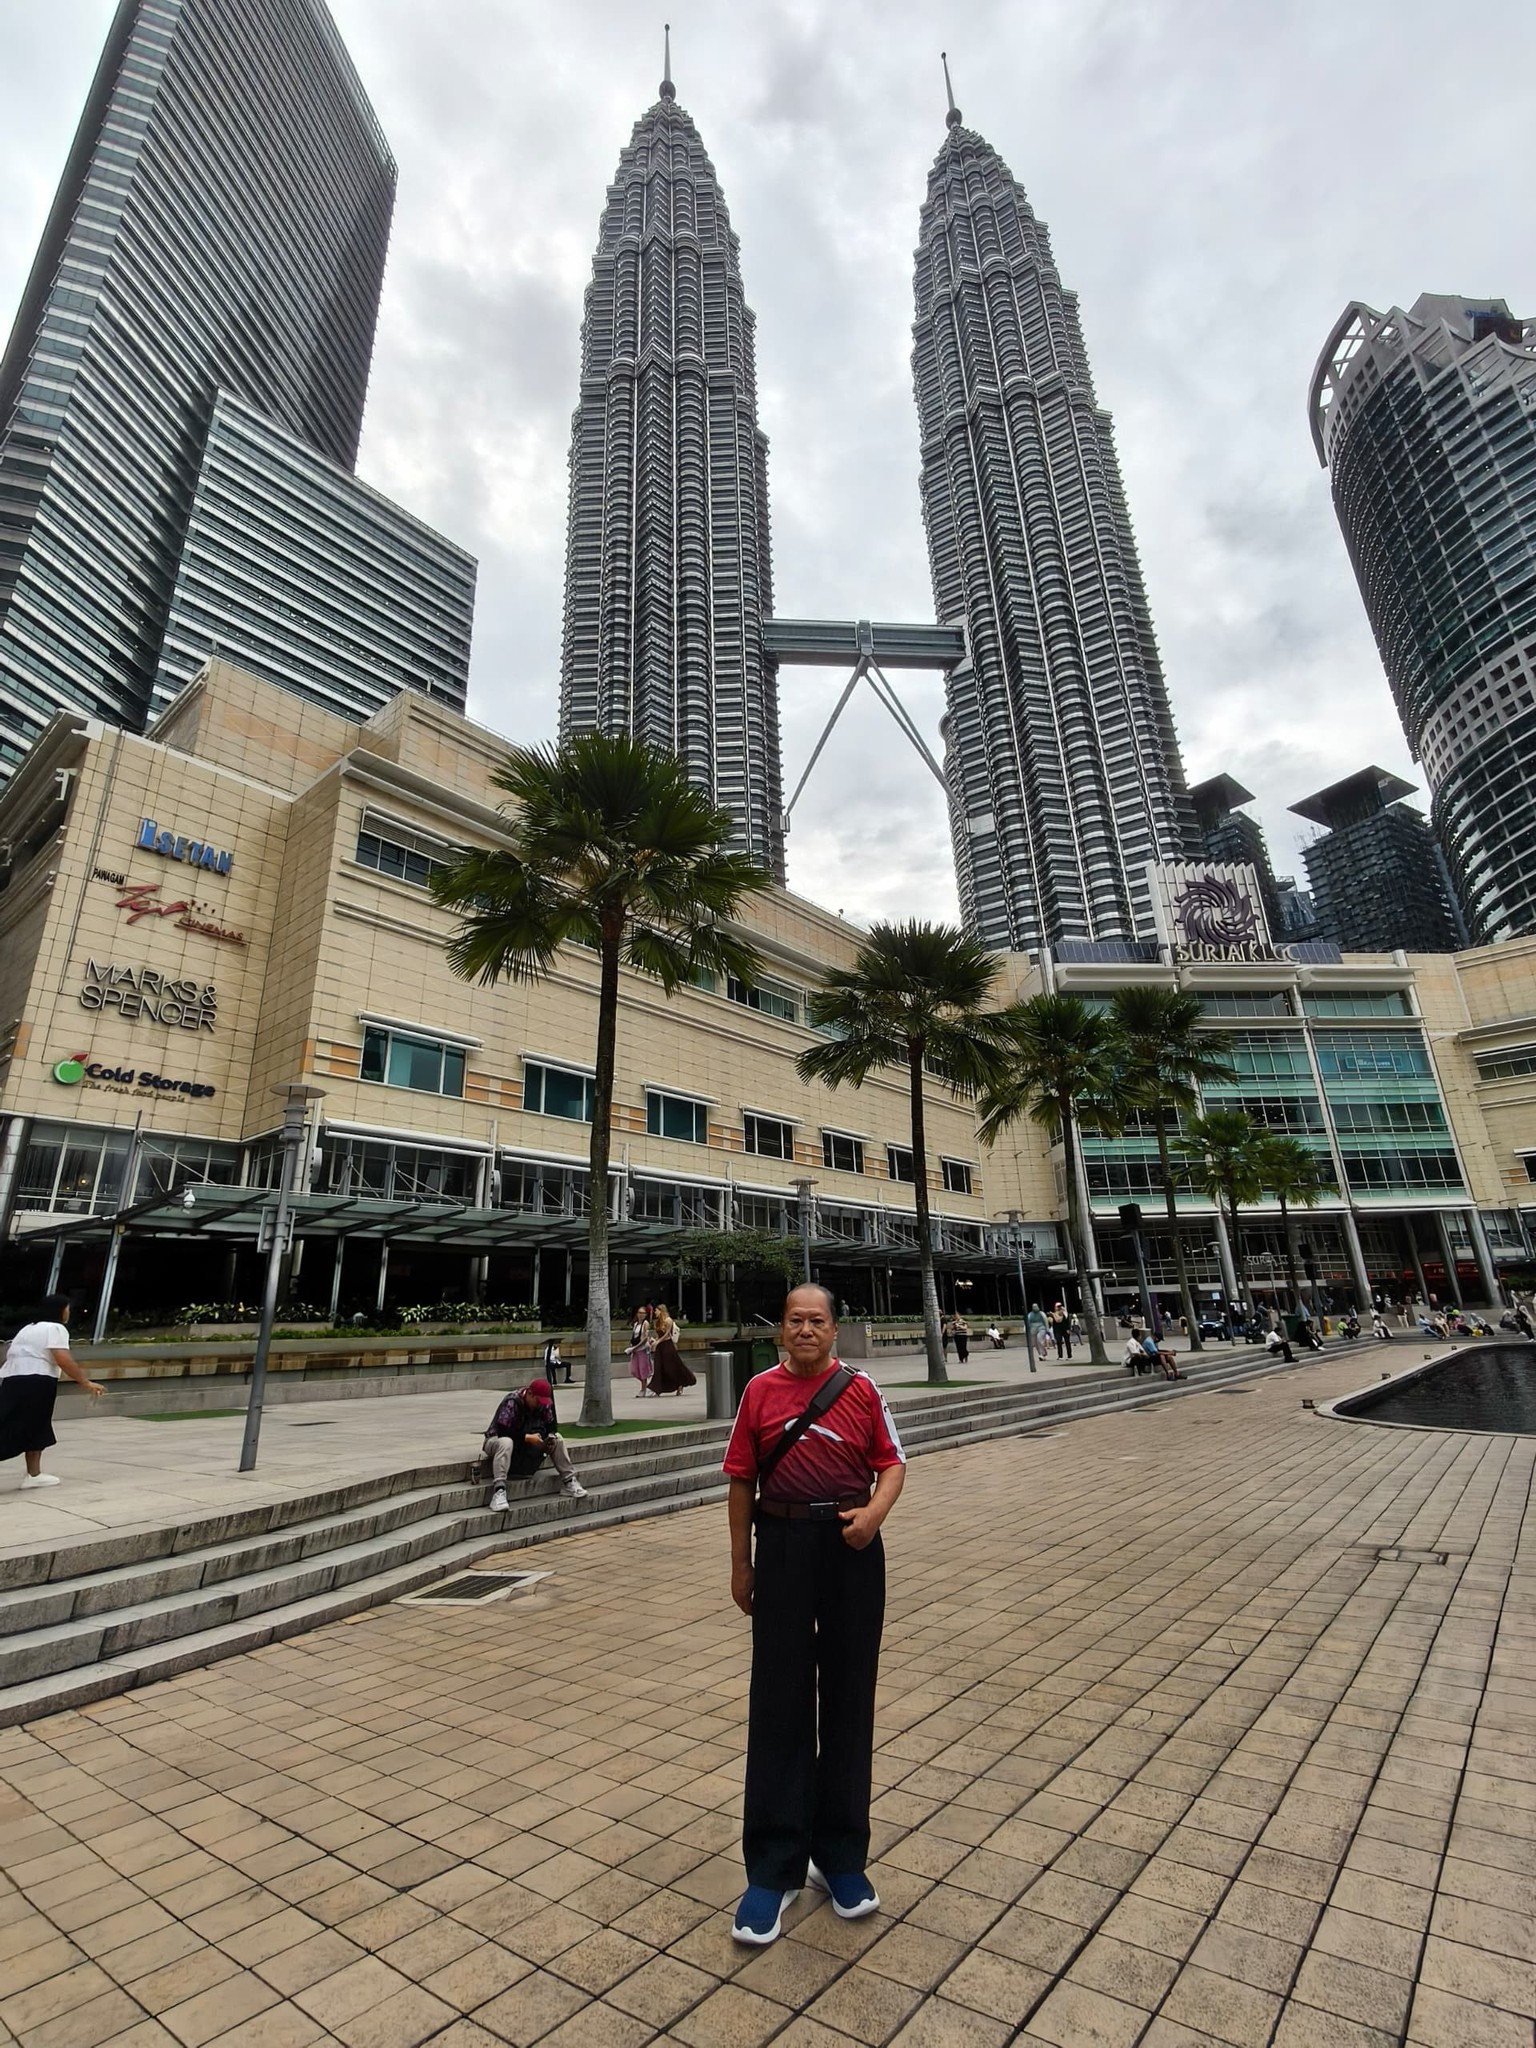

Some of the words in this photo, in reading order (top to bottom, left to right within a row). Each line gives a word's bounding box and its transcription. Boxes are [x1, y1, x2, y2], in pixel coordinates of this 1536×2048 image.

[137, 817, 234, 873] ISETAN
[92, 867, 125, 885] PAWAGAM
[179, 916, 244, 941] CINEMAS
[1175, 942, 1243, 961] SURIA
[85, 956, 198, 1002] MARKS
[200, 984, 218, 1008] &
[80, 983, 217, 1033] SPENCER
[82, 1080, 101, 1090] The
[103, 1084, 130, 1095] fresh
[85, 1063, 135, 1084] Cold
[138, 1072, 216, 1097] Storage
